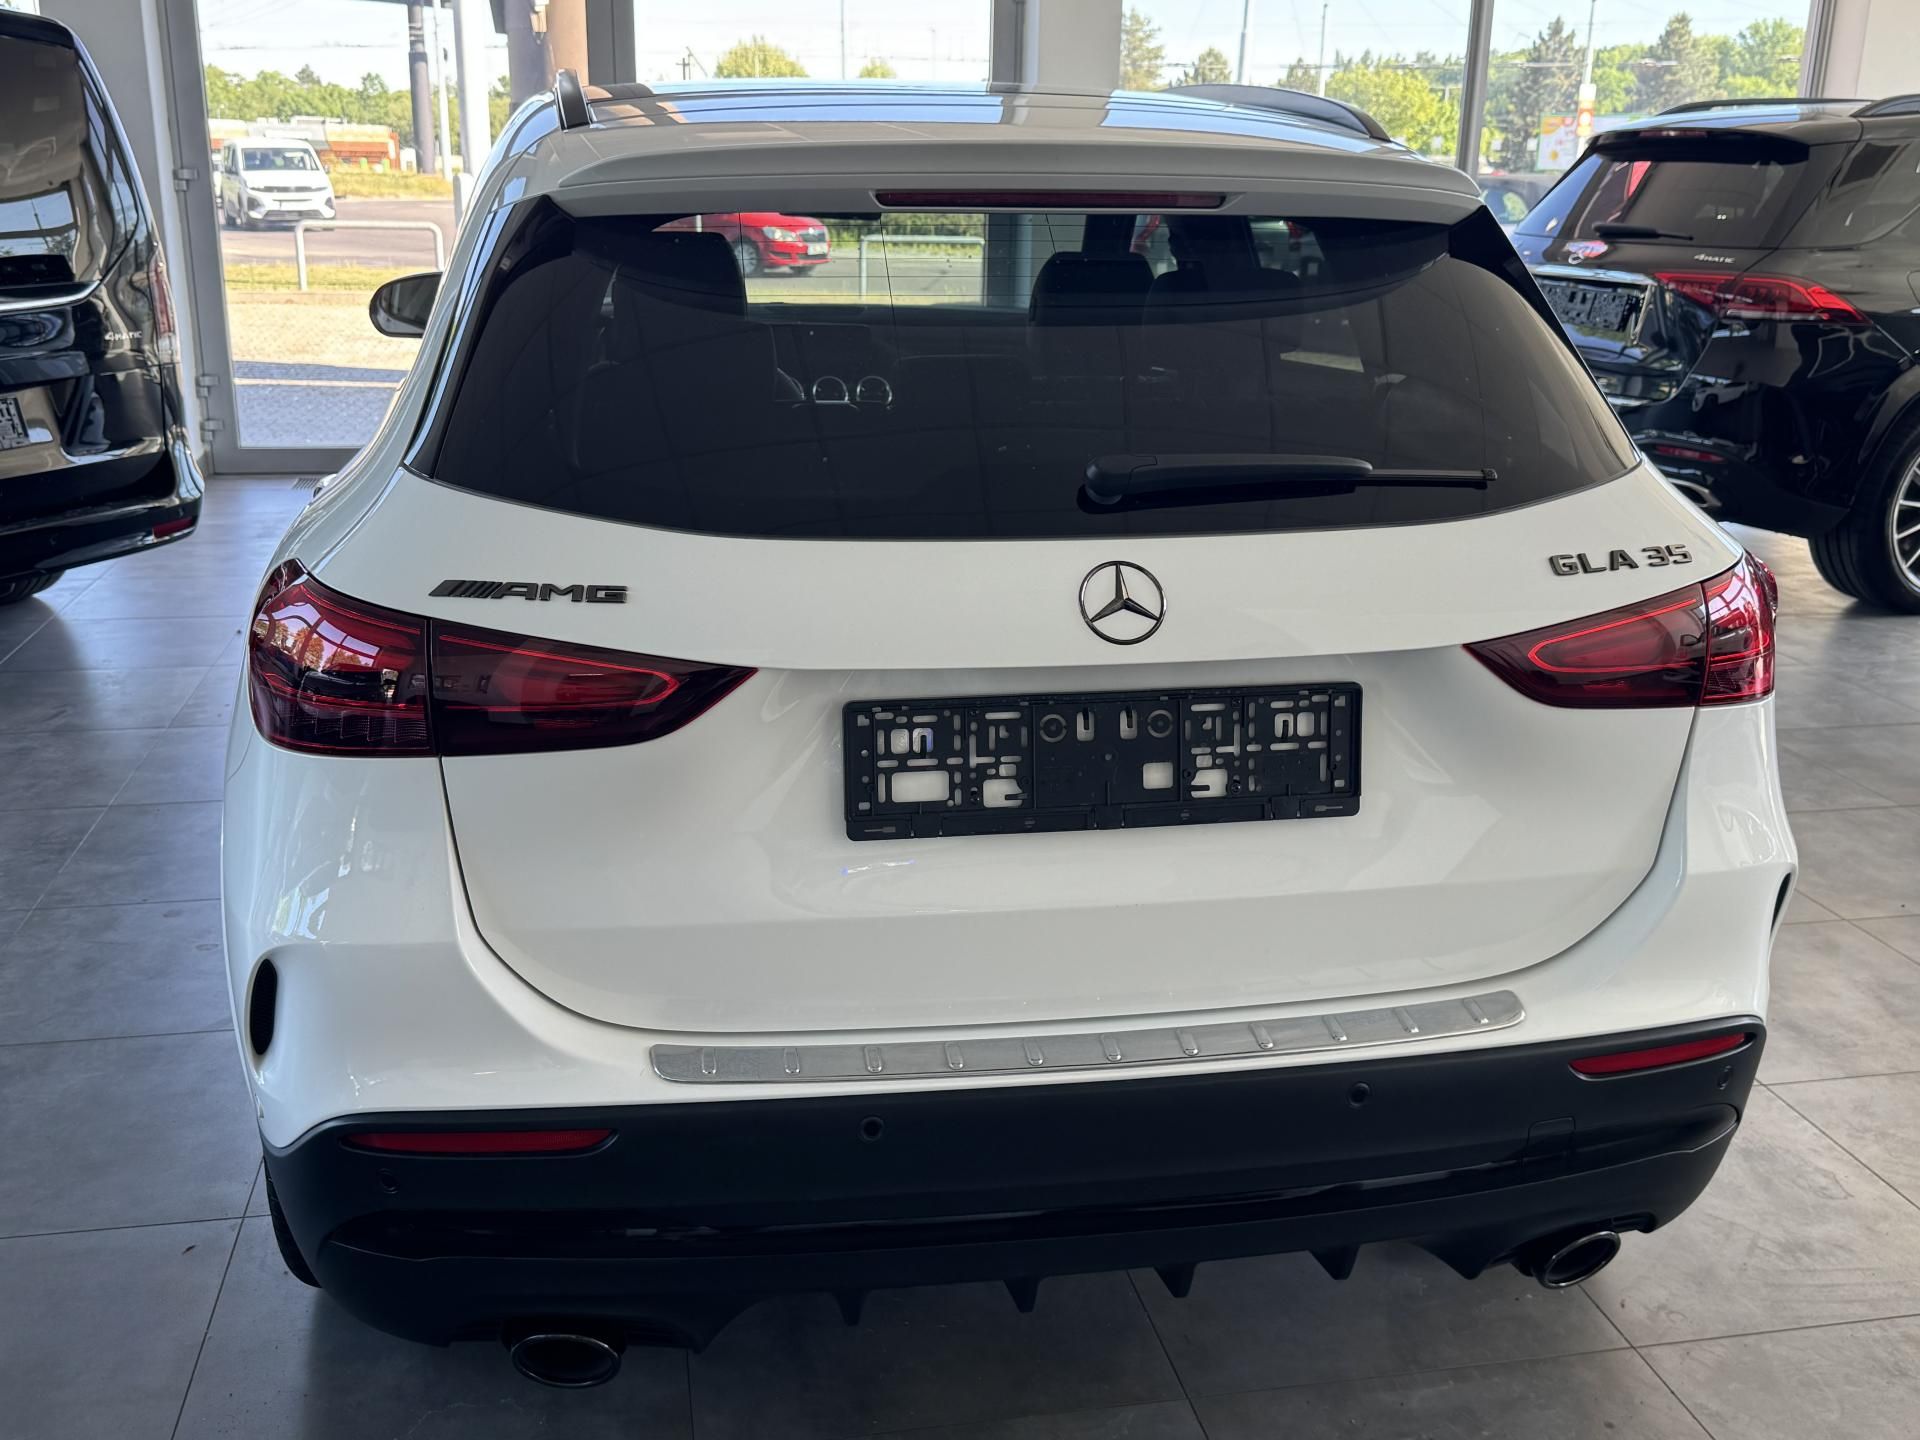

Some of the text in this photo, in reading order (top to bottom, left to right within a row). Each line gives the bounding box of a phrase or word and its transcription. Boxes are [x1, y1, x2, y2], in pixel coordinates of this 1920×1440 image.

[1548, 543, 1693, 576] GLA 35
[490, 581, 628, 604] AMG
